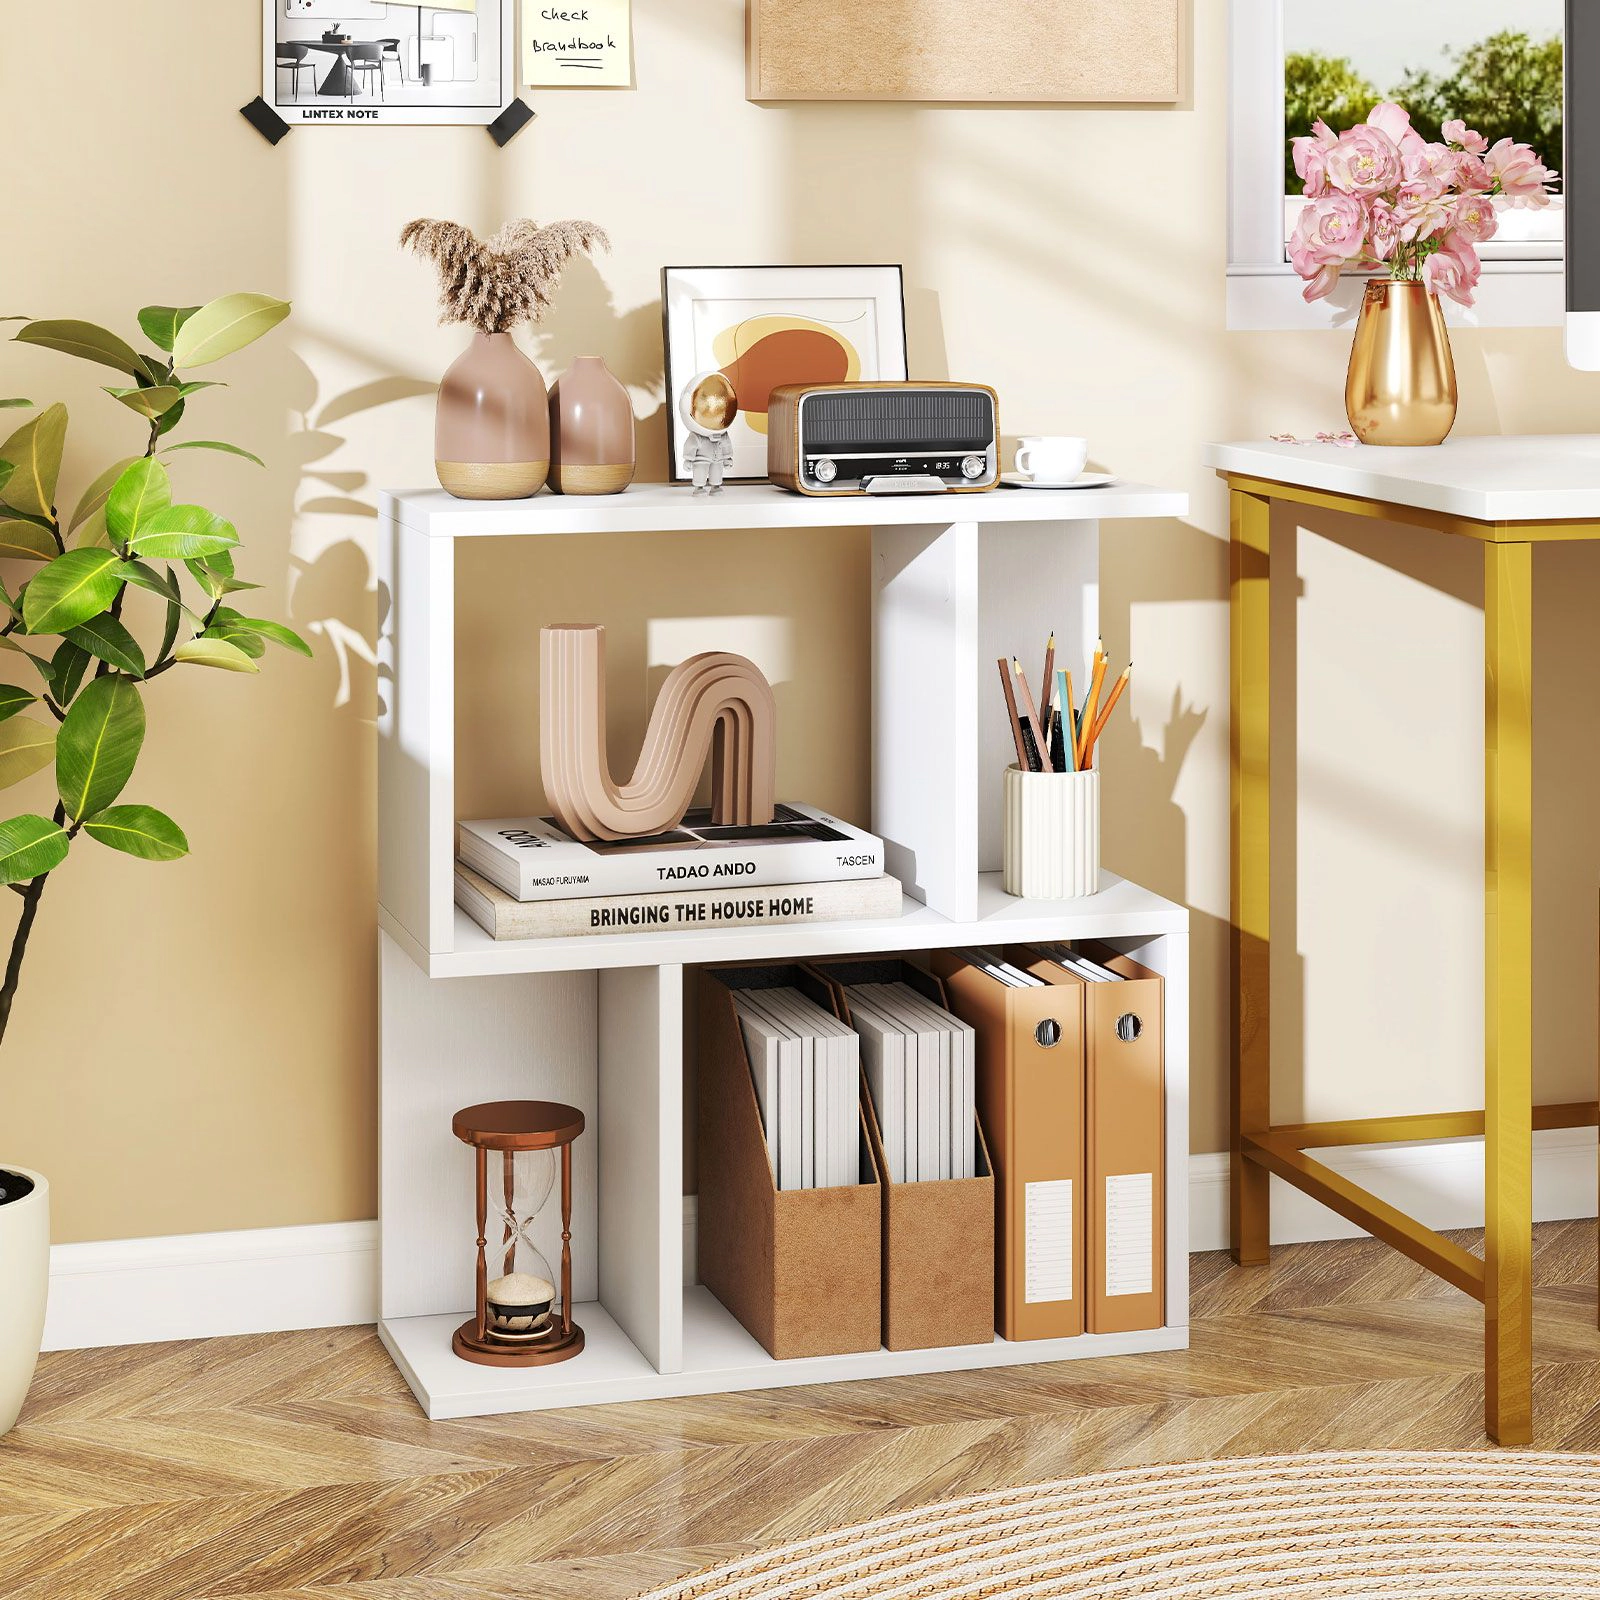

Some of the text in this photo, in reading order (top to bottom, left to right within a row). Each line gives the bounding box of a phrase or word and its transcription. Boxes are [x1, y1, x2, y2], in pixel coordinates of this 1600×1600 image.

[533, 34, 616, 53] Brandbook
[302, 110, 379, 119] LINTEX NOTE
[497, 830, 551, 848] ANDO
[836, 855, 875, 867] TASCEN
[657, 862, 756, 880] TADAO ANDO
[532, 877, 555, 886] MASAO
[590, 897, 814, 927] BRINGING THE HOUSE HOME
